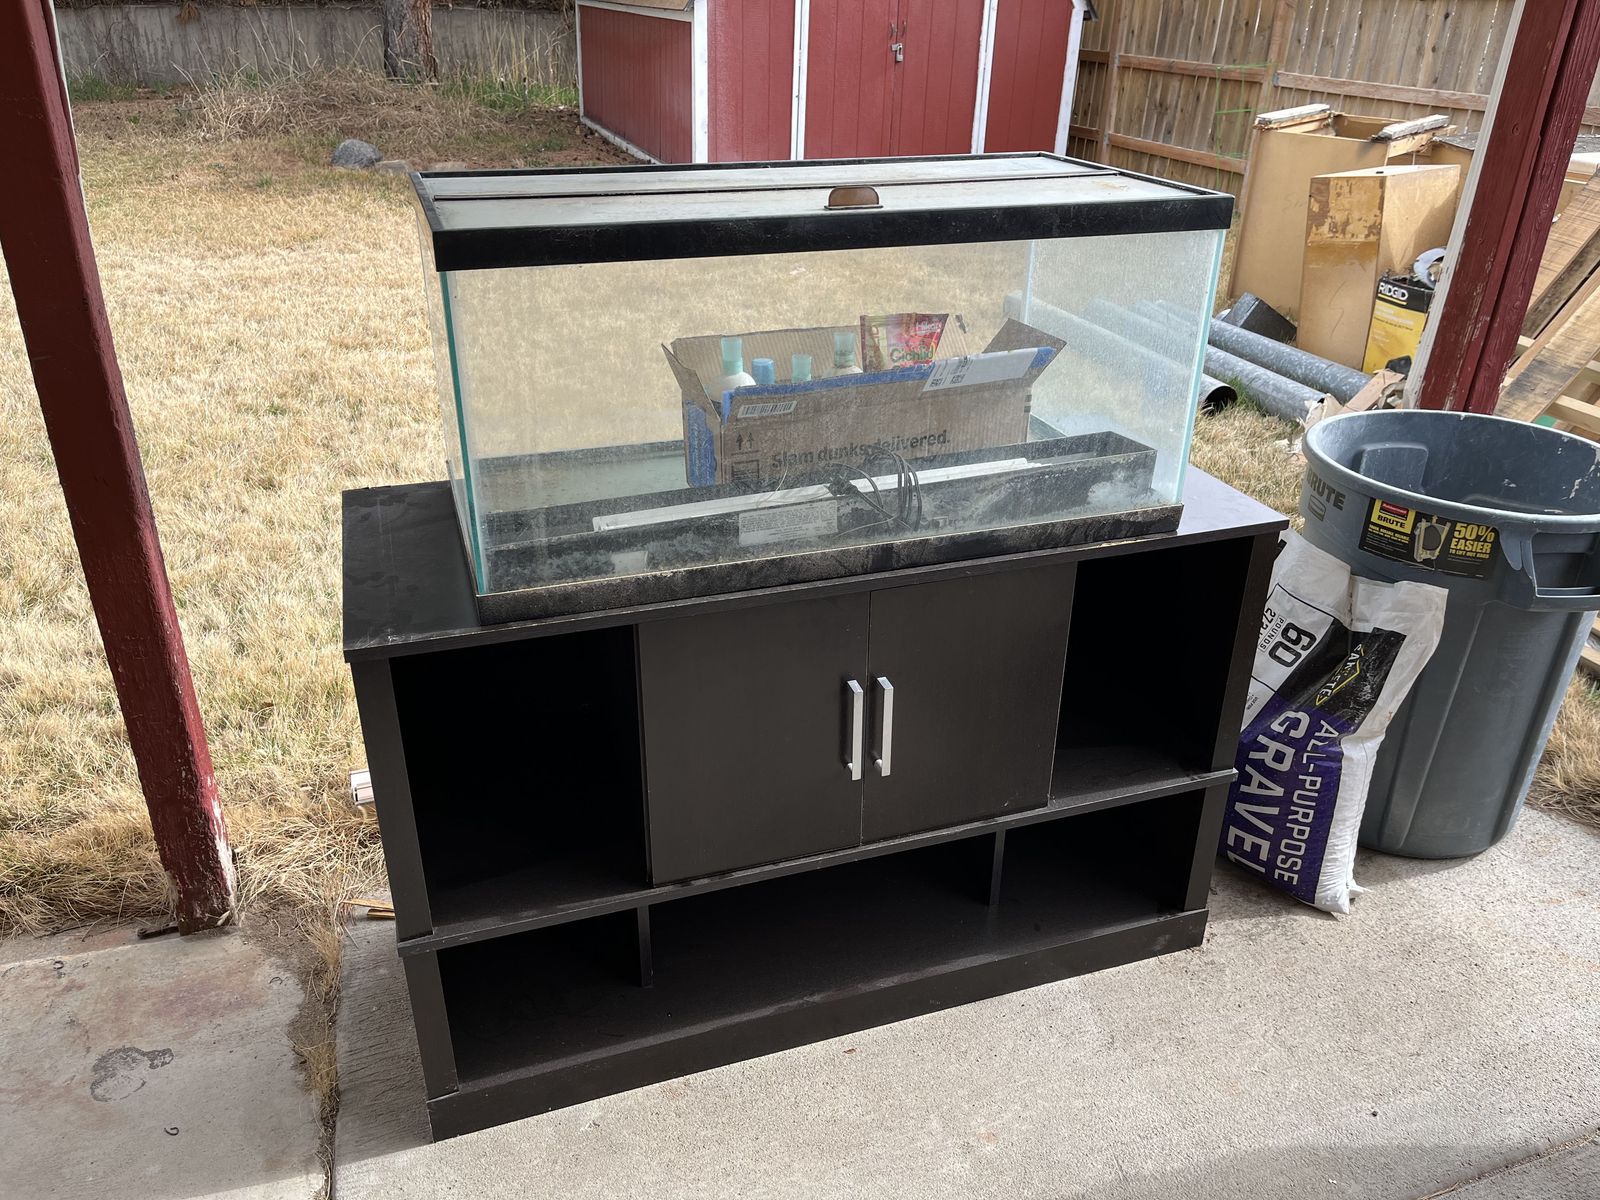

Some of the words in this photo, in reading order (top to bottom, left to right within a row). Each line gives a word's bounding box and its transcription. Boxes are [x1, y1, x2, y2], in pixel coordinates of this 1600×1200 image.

[1378, 282, 1409, 300] RIDGID
[890, 343, 934, 363] Cichlid
[772, 450, 814, 468] Slam
[817, 441, 869, 463] dunks
[872, 429, 951, 454] delivered.
[1307, 469, 1346, 511] BRUTE
[1377, 514, 1407, 529] BRUTE
[1453, 522, 1496, 542] 50%
[1450, 537, 1492, 554] EASIER
[1259, 617, 1285, 650] POUNDS
[1268, 622, 1317, 668] 60
[1226, 709, 1311, 874] GRAVEL
[1274, 719, 1338, 885] ALL-PURPOSE
